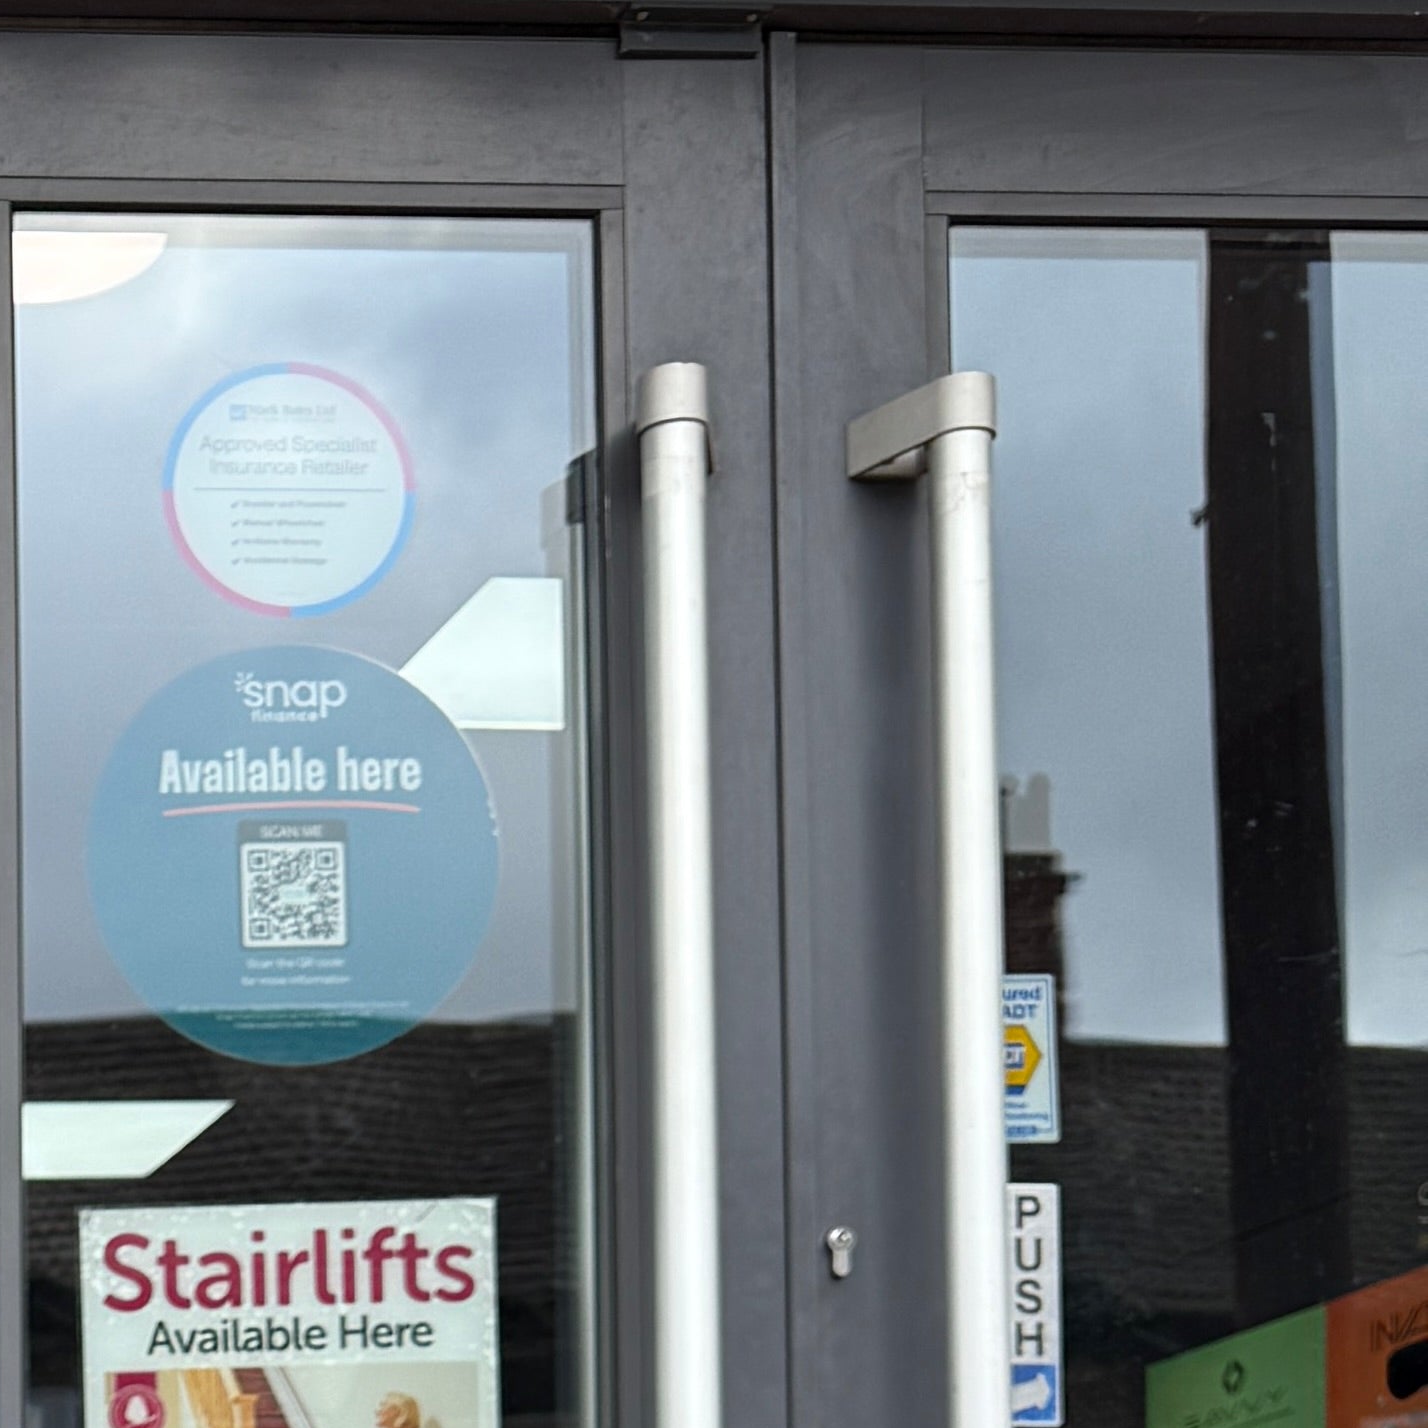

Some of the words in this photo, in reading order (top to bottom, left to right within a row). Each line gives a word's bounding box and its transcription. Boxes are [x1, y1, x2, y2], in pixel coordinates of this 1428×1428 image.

[200, 435, 287, 456] Approved
[291, 436, 378, 456] Specialist
[209, 459, 297, 475] Insurance
[301, 459, 369, 476] Retailer
[243, 679, 347, 719] snap
[159, 746, 328, 794] Available
[336, 745, 423, 792] here
[1002, 985, 1041, 1001] ured
[103, 1225, 476, 1312] Stairlifts
[1014, 1194, 1044, 1357] PUSH
[147, 1317, 328, 1355] Available
[339, 1314, 434, 1349] Here
